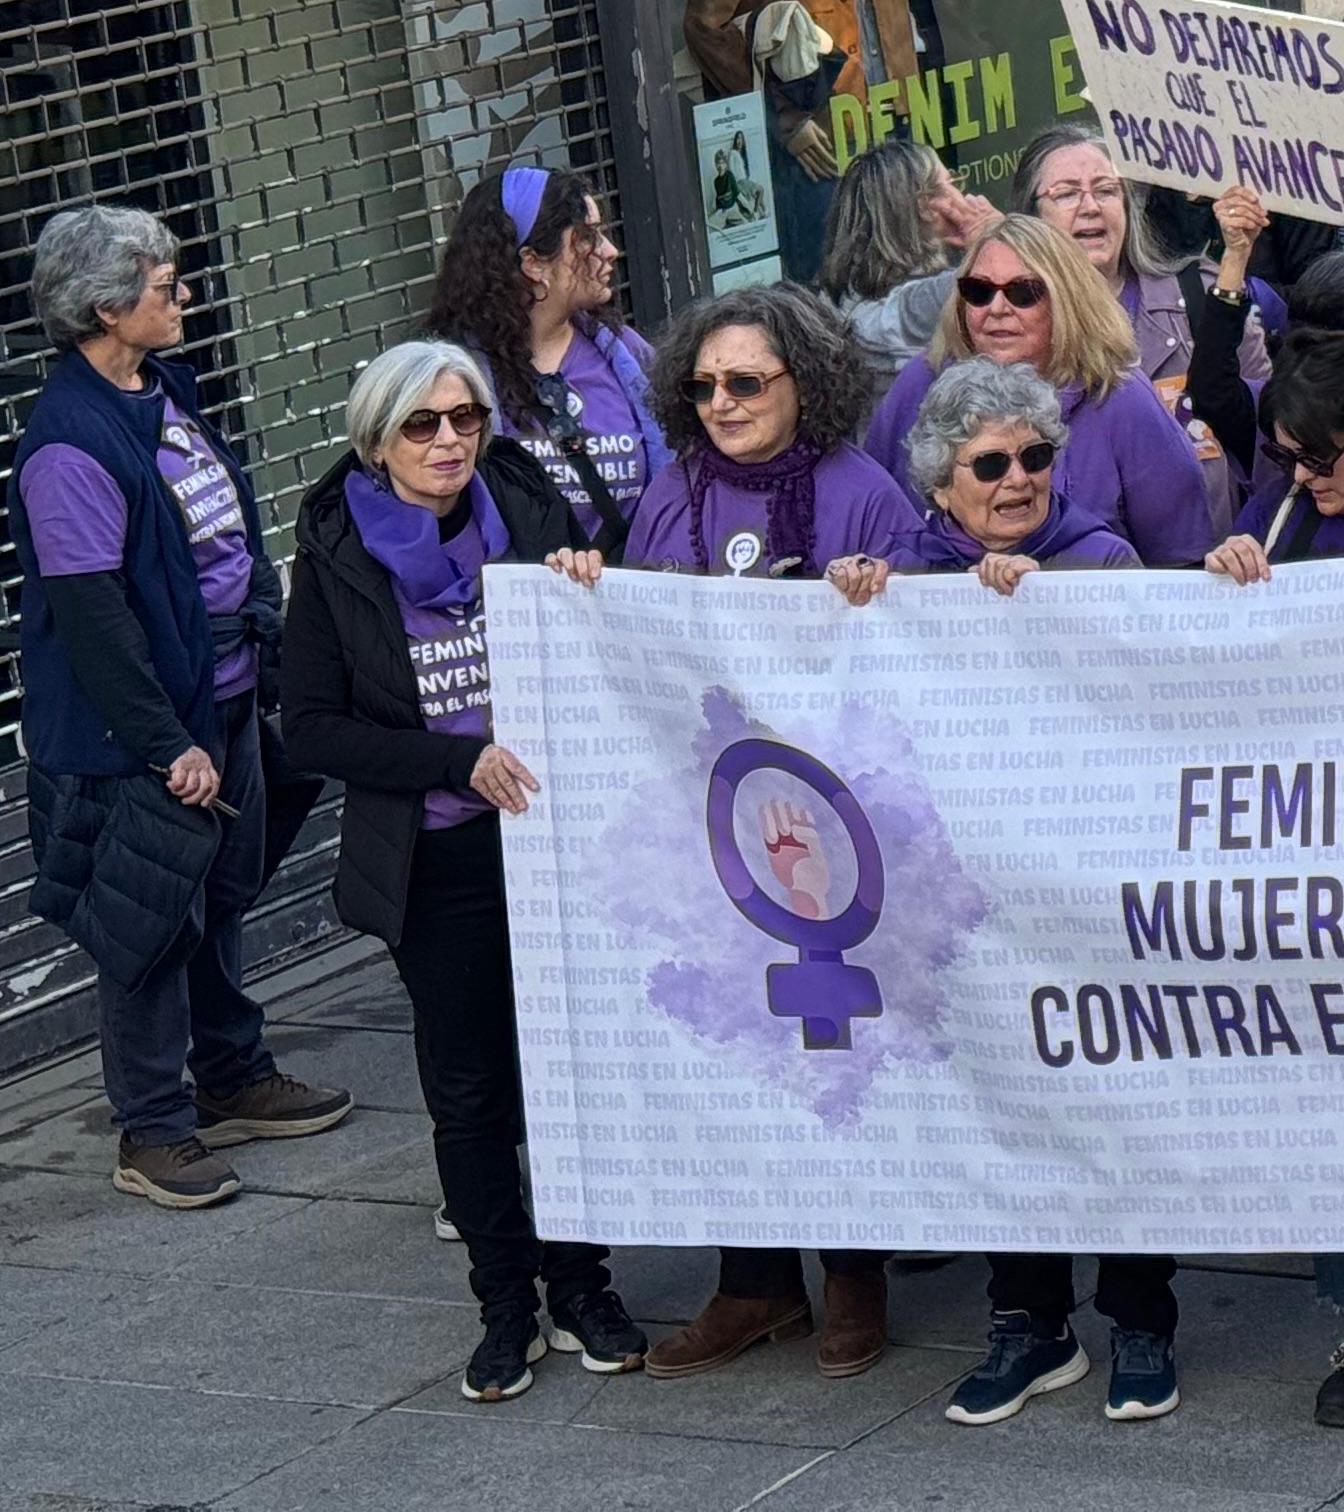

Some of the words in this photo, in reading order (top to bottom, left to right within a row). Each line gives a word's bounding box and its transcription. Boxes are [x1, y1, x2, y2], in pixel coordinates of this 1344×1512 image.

[1166, 69, 1217, 119] QUE
[1227, 80, 1268, 129] EL
[1110, 108, 1223, 183] PASADO
[791, 616, 915, 644] FEMINISTAS
[913, 615, 944, 640] EN
[949, 617, 1013, 640] LUCHA
[849, 646, 968, 676] FEMINISTAS
[972, 651, 1000, 672] EN
[1003, 644, 1065, 672] LUCHA
[1077, 643, 1188, 669] FEMINISTAS
[1190, 646, 1217, 668] EN
[1221, 643, 1286, 665] LUCHA
[446, 696, 464, 713] EL
[1083, 745, 1201, 772] FEMINISTAS
[1204, 743, 1231, 764] EN
[1236, 741, 1298, 766] LUCHA
[1030, 983, 1301, 1069] CONTRA
[1185, 1061, 1304, 1089] FEMINISTAS
[1308, 1059, 1337, 1085] EN
[556, 1150, 661, 1181] FEMINISTAS
[661, 1157, 689, 1180] EN
[688, 1155, 751, 1181] LUCHA
[763, 1154, 878, 1181] FEMINISTAS
[881, 1159, 908, 1181] EN
[907, 1160, 970, 1183] LUCHA
[648, 1185, 761, 1211] FEMINISTAS
[765, 1185, 792, 1210] EN
[792, 1185, 856, 1211] LUCHA
[705, 1216, 813, 1240] FEMINISTAS
[816, 1223, 842, 1240] EN
[847, 1218, 907, 1240] LUCHA
[1141, 1227, 1253, 1245] FEMINISTAS
[1259, 1227, 1283, 1245] EN
